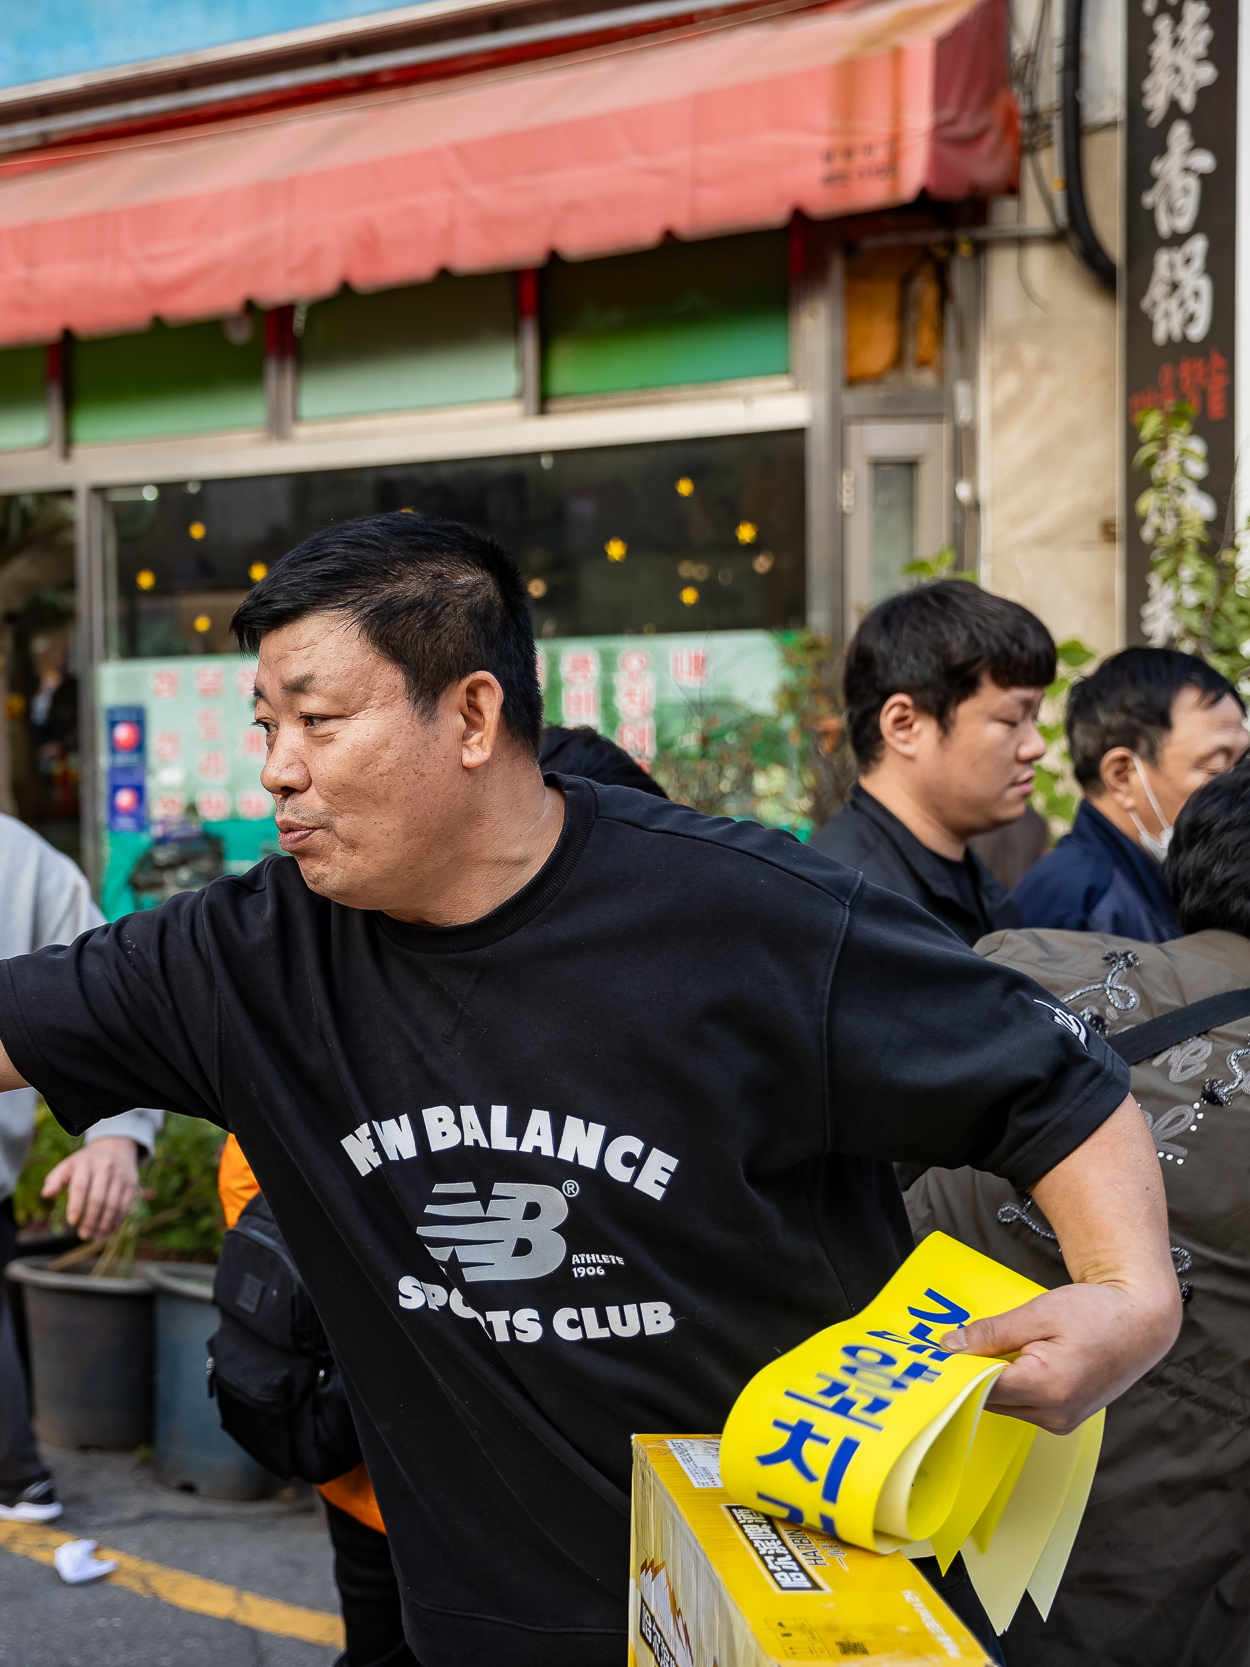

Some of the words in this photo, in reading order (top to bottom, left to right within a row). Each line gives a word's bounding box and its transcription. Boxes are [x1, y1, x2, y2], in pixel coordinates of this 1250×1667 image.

[422, 1105, 679, 1201] BALANCE
[571, 1253, 625, 1266] ATHLETE
[572, 1266, 606, 1278] 1906
[398, 1276, 544, 1344] SPOTS
[552, 1301, 676, 1339] CLUB
[784, 1529, 828, 1567] HARBIN
[641, 1601, 678, 1667] 哈尔滨
